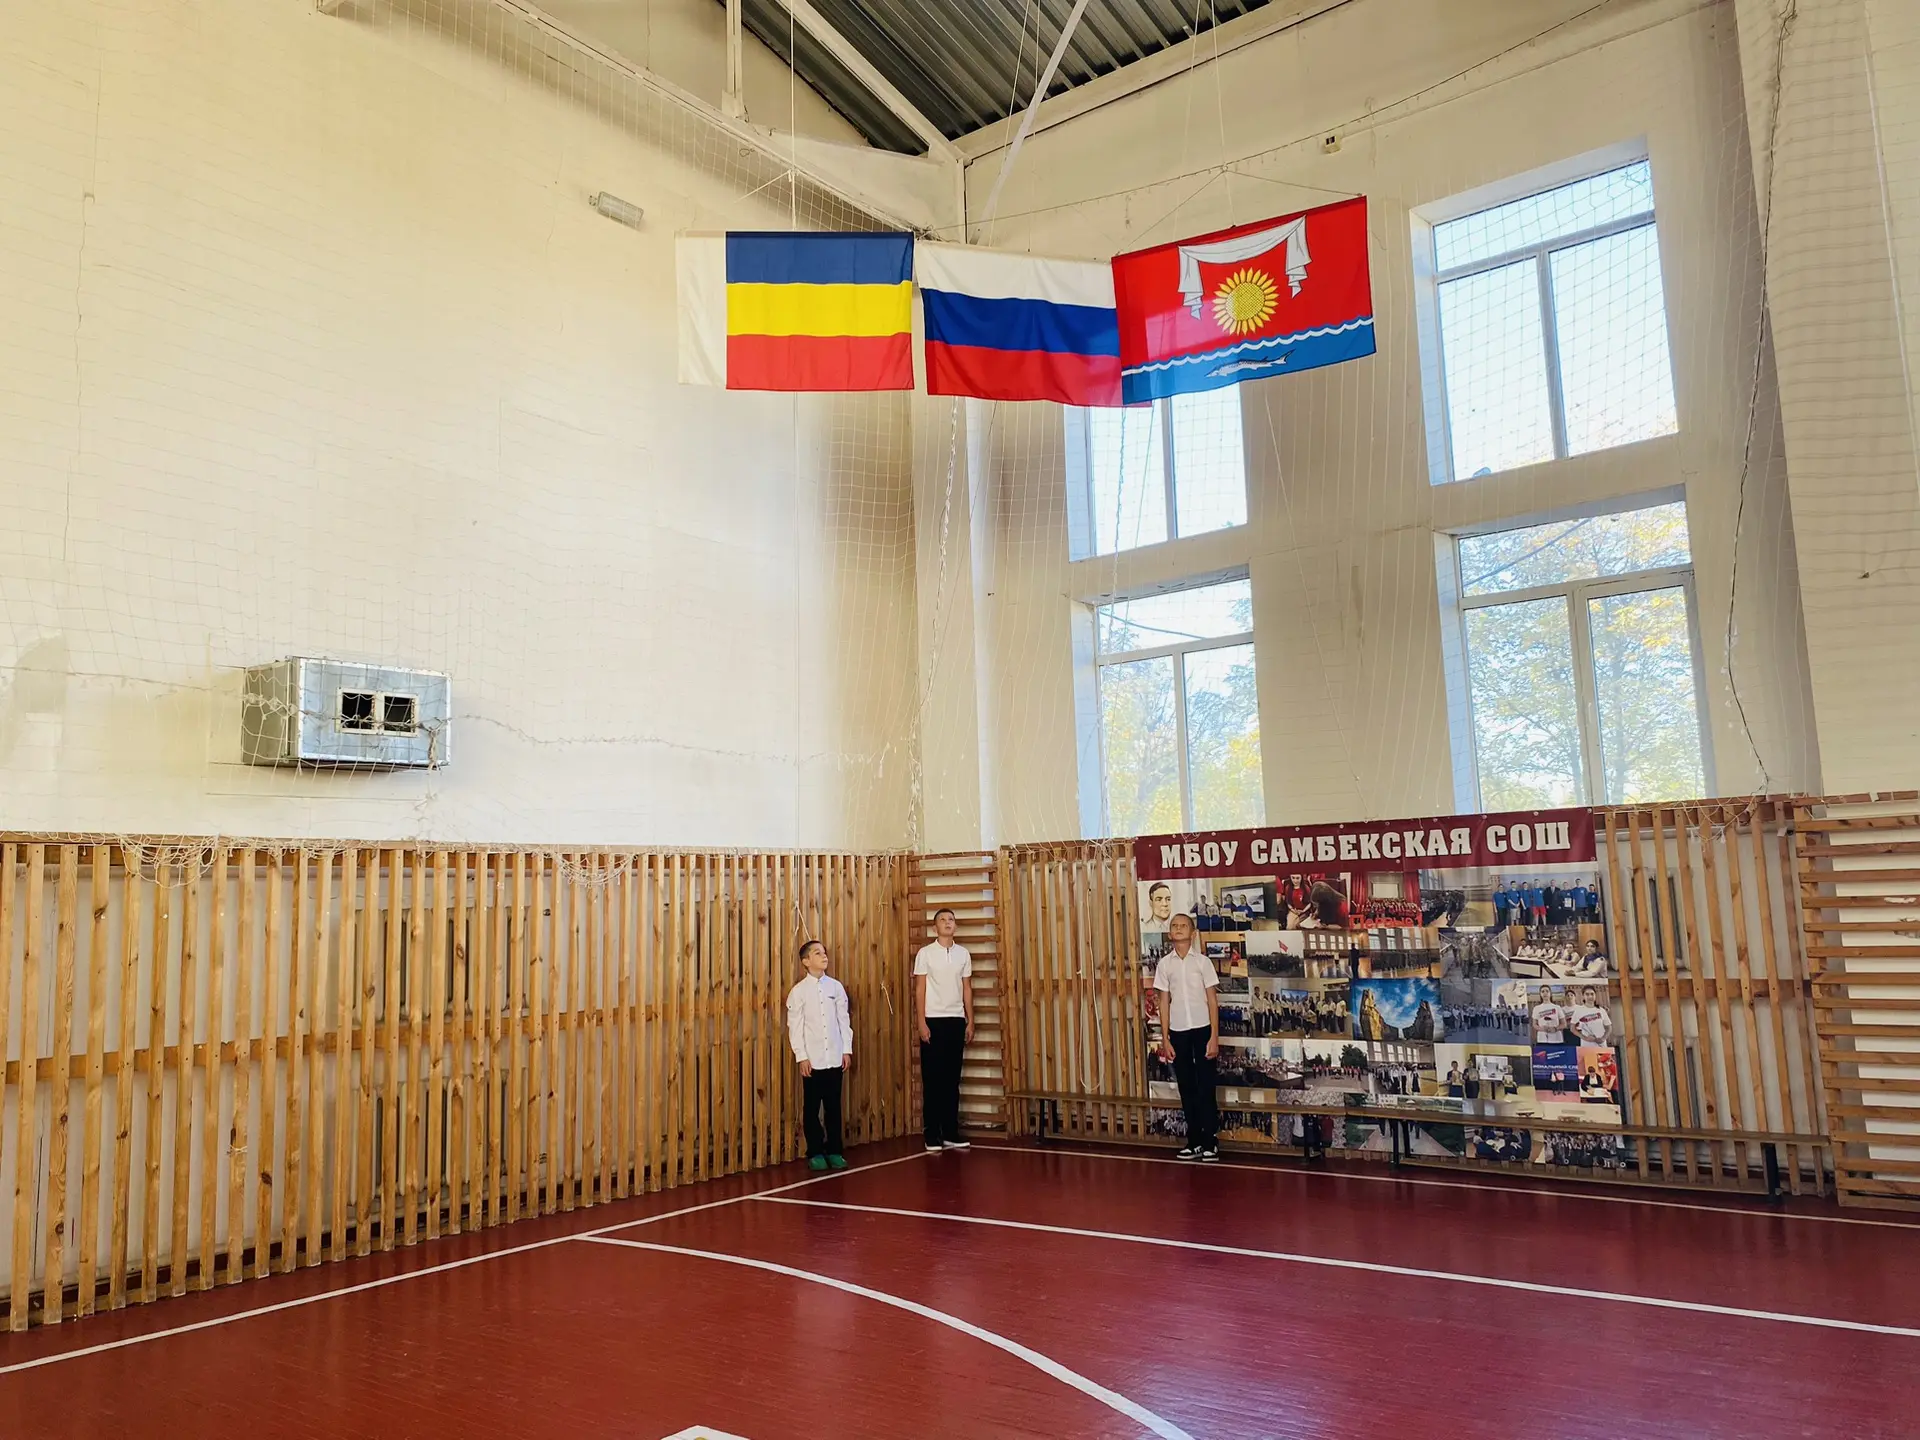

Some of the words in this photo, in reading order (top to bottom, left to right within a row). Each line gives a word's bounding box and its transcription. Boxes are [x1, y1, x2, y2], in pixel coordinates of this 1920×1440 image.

[1160, 841, 1239, 869] МБОУ
[1250, 827, 1472, 865] САМБЕКСКАЯ
[1486, 821, 1571, 854] СОШ
